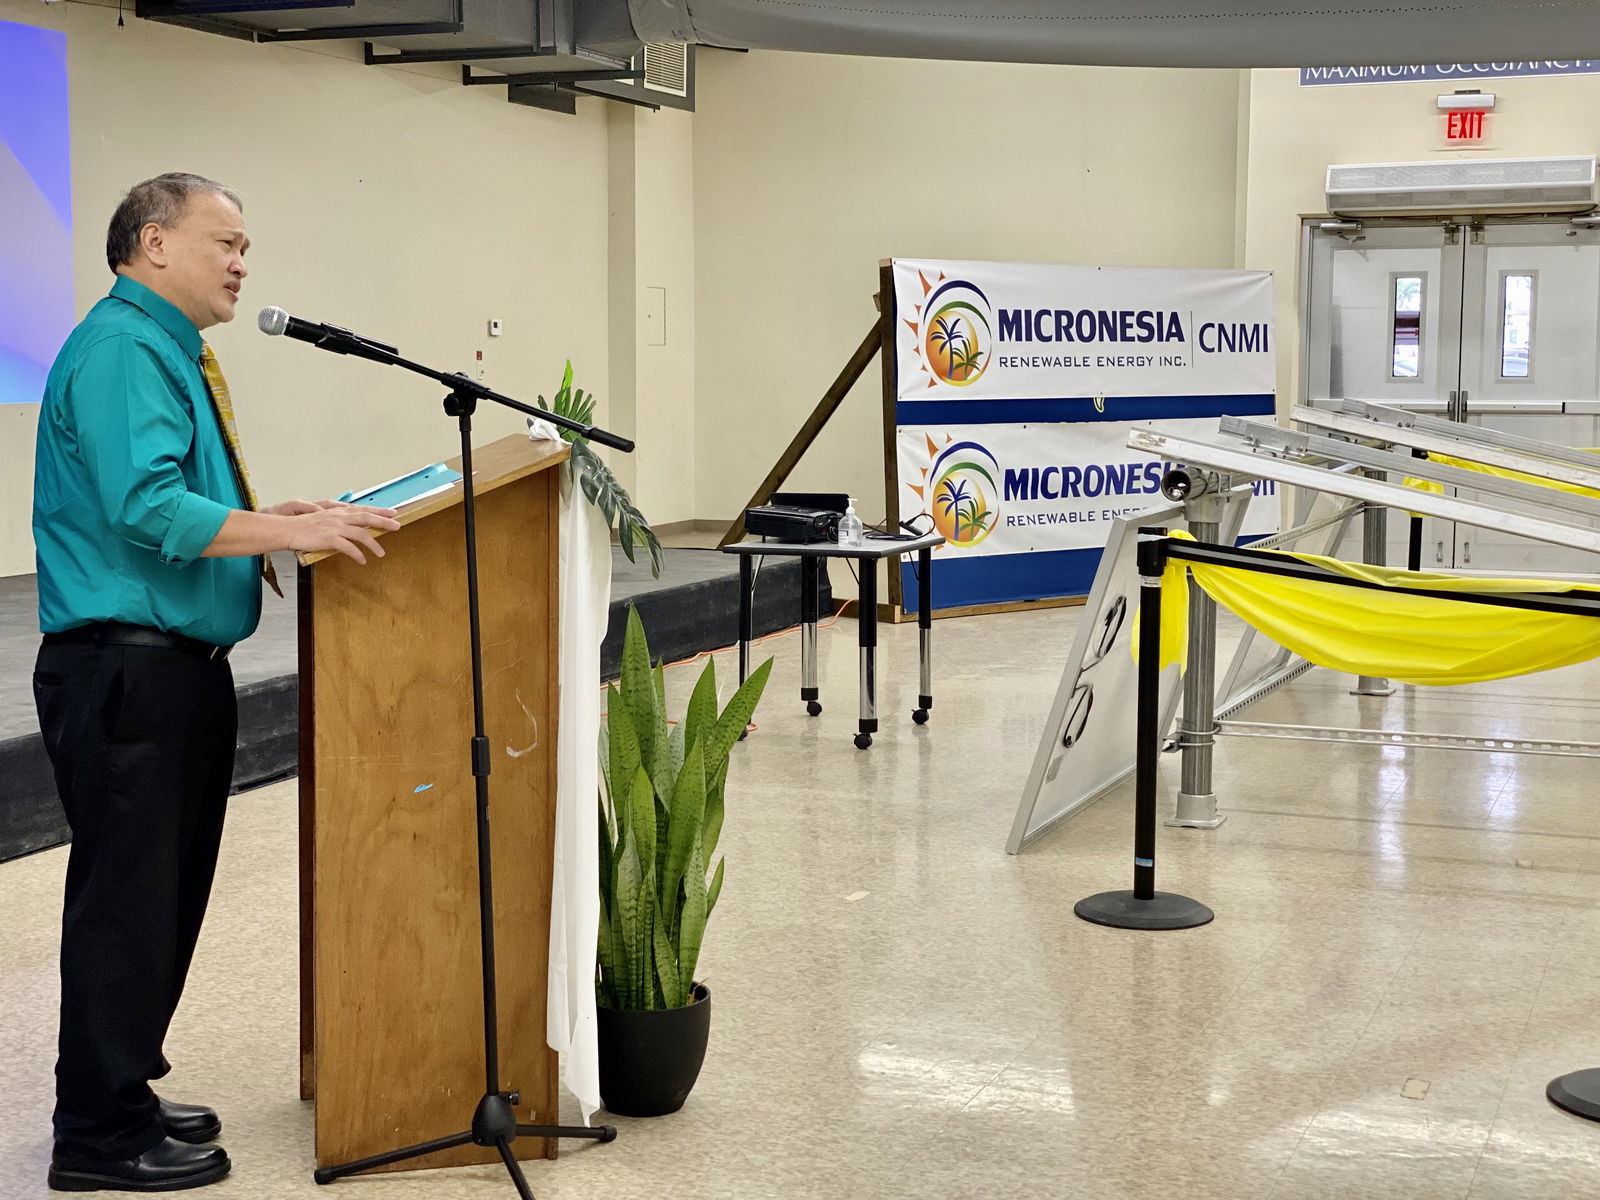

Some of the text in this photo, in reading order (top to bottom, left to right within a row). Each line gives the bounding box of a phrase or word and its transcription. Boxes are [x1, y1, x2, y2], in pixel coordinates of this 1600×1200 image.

[1447, 112, 1485, 139] EXIT
[998, 309, 1186, 343] MICRONESIA
[1199, 322, 1269, 353] CNMI
[999, 355, 1187, 368] RENEWABLE ENERGY INC.
[1004, 461, 1184, 501] MICRONES
[1006, 510, 1096, 527] RENEWABLE
